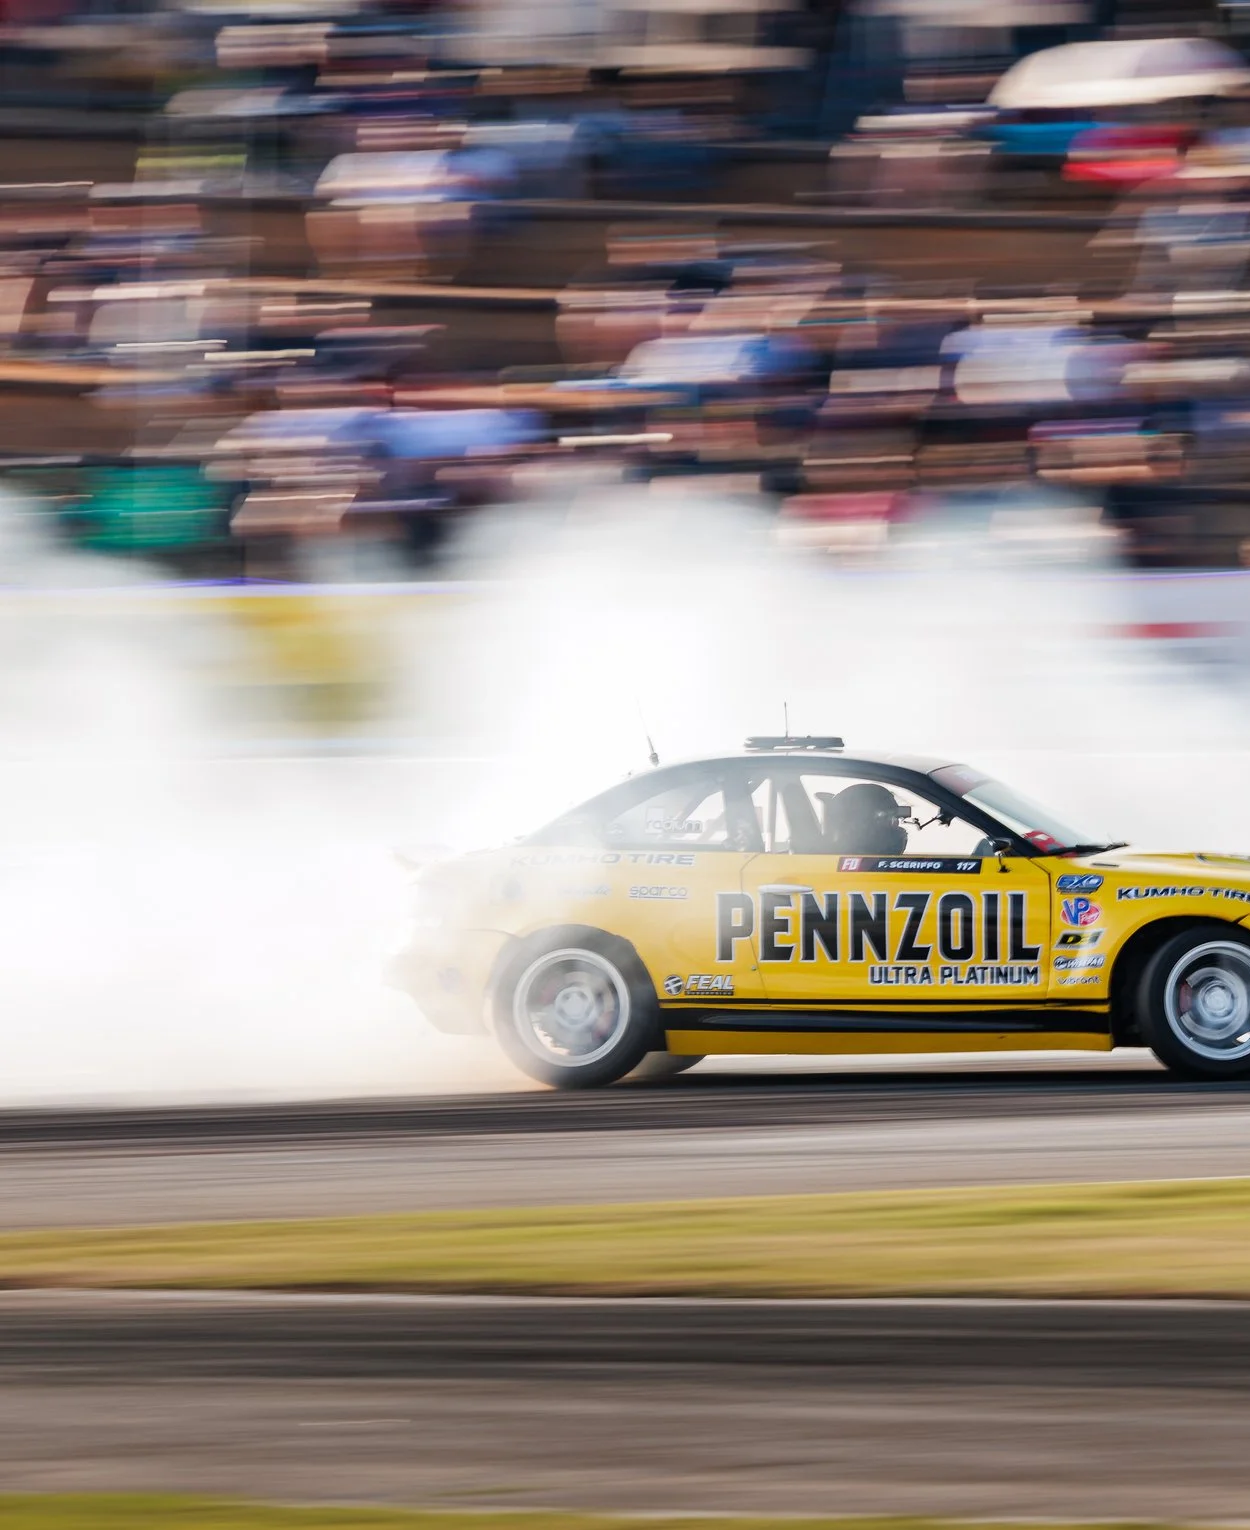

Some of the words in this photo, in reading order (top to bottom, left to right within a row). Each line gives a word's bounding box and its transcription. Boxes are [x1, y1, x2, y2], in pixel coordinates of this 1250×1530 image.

[627, 853, 696, 866] TIRE
[889, 860, 941, 870] SCERIFFO
[956, 861, 978, 871] 117
[629, 885, 689, 898] sparco
[1116, 886, 1204, 901] KUMHO
[1061, 897, 1091, 927] VP
[715, 891, 1043, 963] PENNZOIL
[685, 973, 735, 990] FEAL
[868, 965, 933, 986] ULTRA
[939, 964, 1041, 986] PLATINUM
